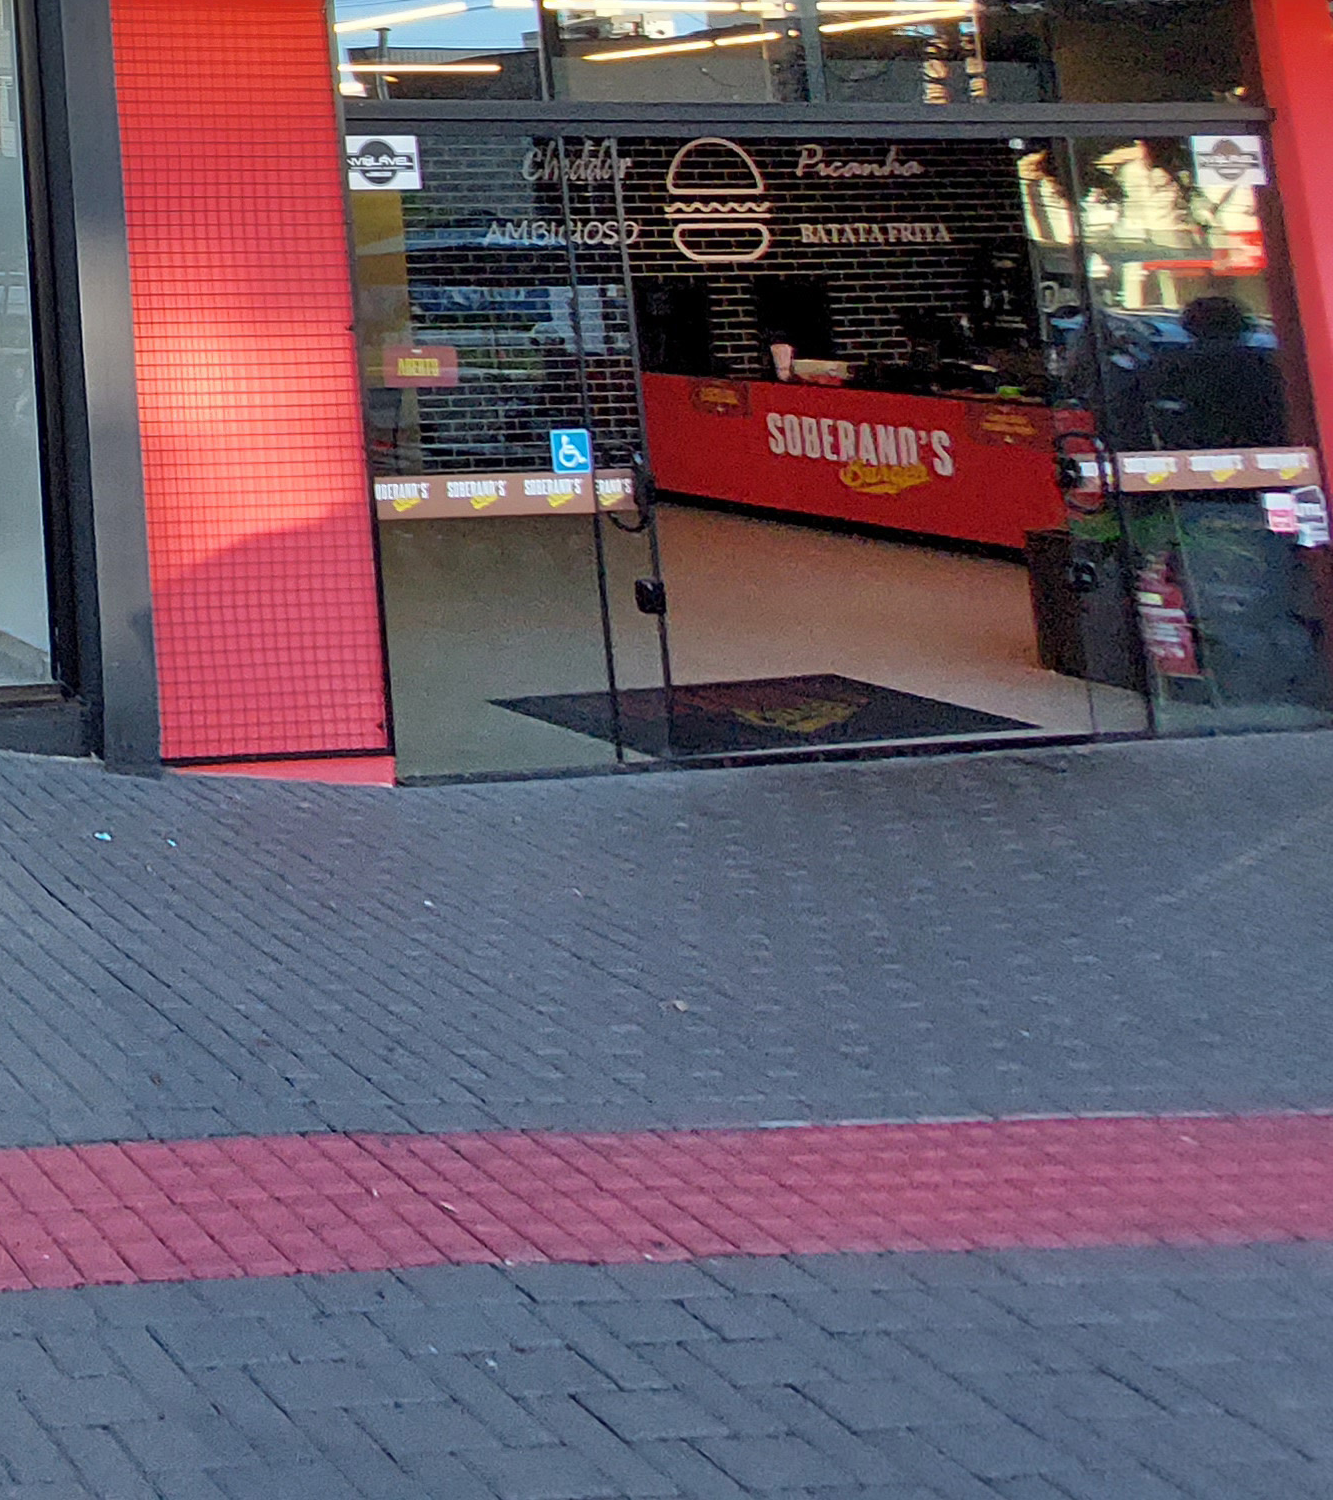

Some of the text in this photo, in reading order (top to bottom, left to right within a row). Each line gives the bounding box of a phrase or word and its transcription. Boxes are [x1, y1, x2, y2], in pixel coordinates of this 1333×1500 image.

[346, 153, 414, 167] NVIOLÁVEL
[795, 143, 926, 178] Picanha
[798, 222, 952, 244] BATATA FRITA
[765, 411, 955, 477] SOBERANO'S
